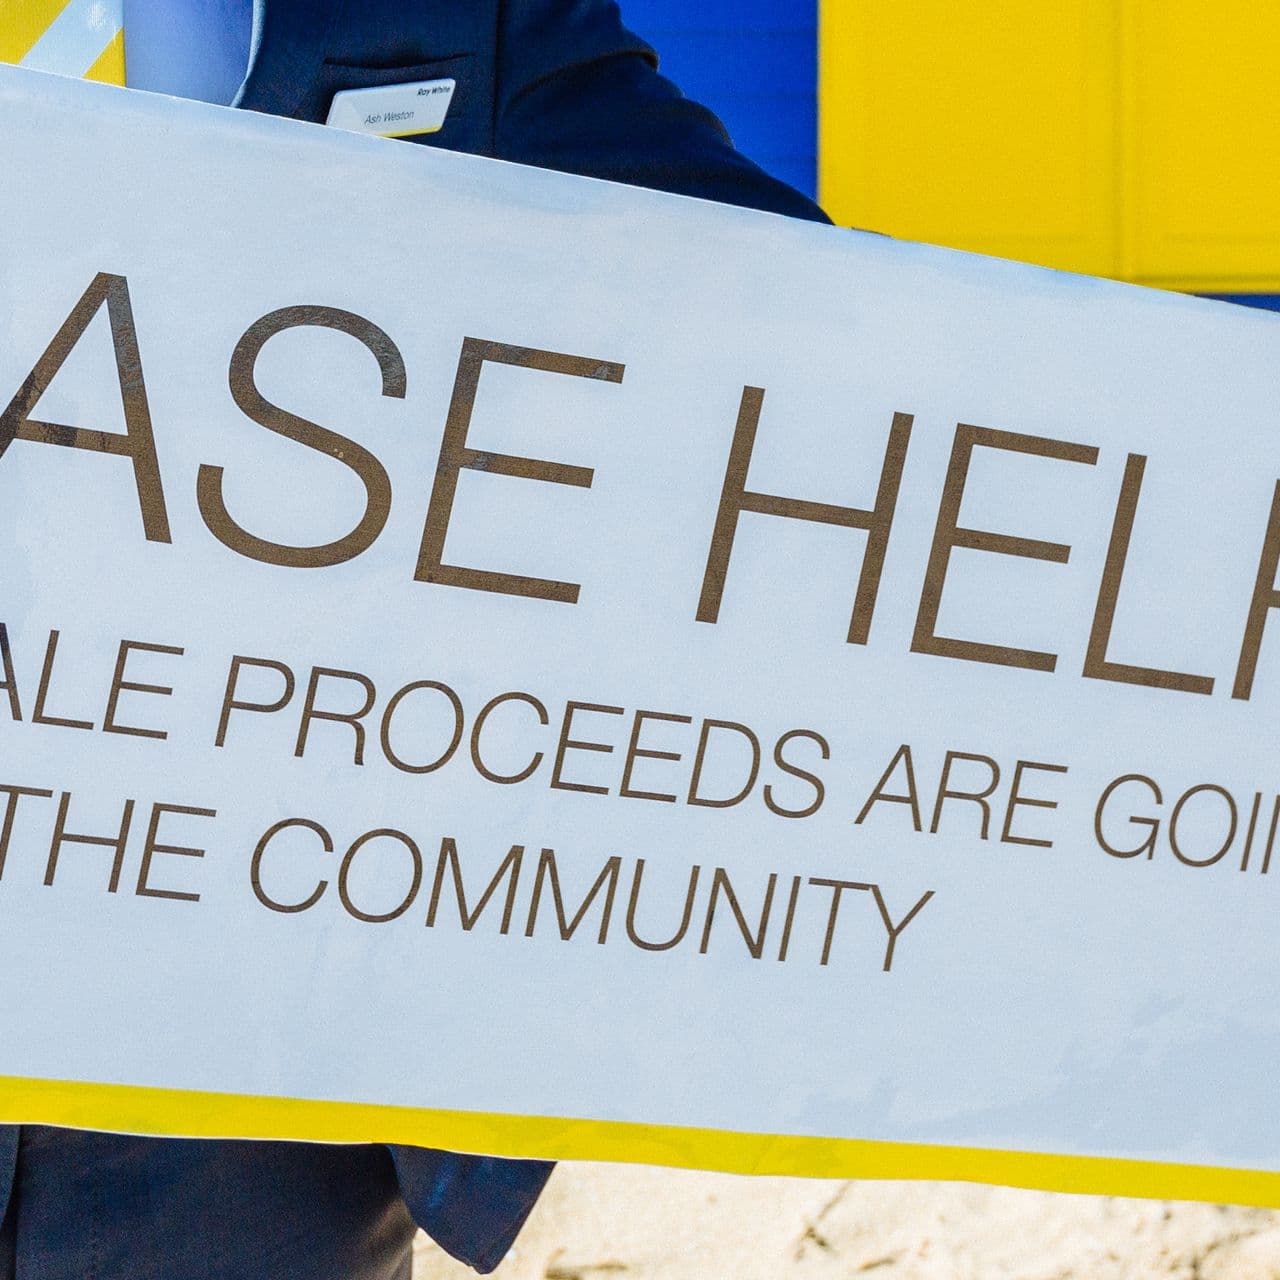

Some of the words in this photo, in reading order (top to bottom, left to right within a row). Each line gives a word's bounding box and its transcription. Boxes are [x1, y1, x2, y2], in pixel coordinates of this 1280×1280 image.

[215, 655, 830, 820] PROCEEDS
[854, 744, 1069, 849] ARE
[251, 818, 936, 974] COMMUNITY
